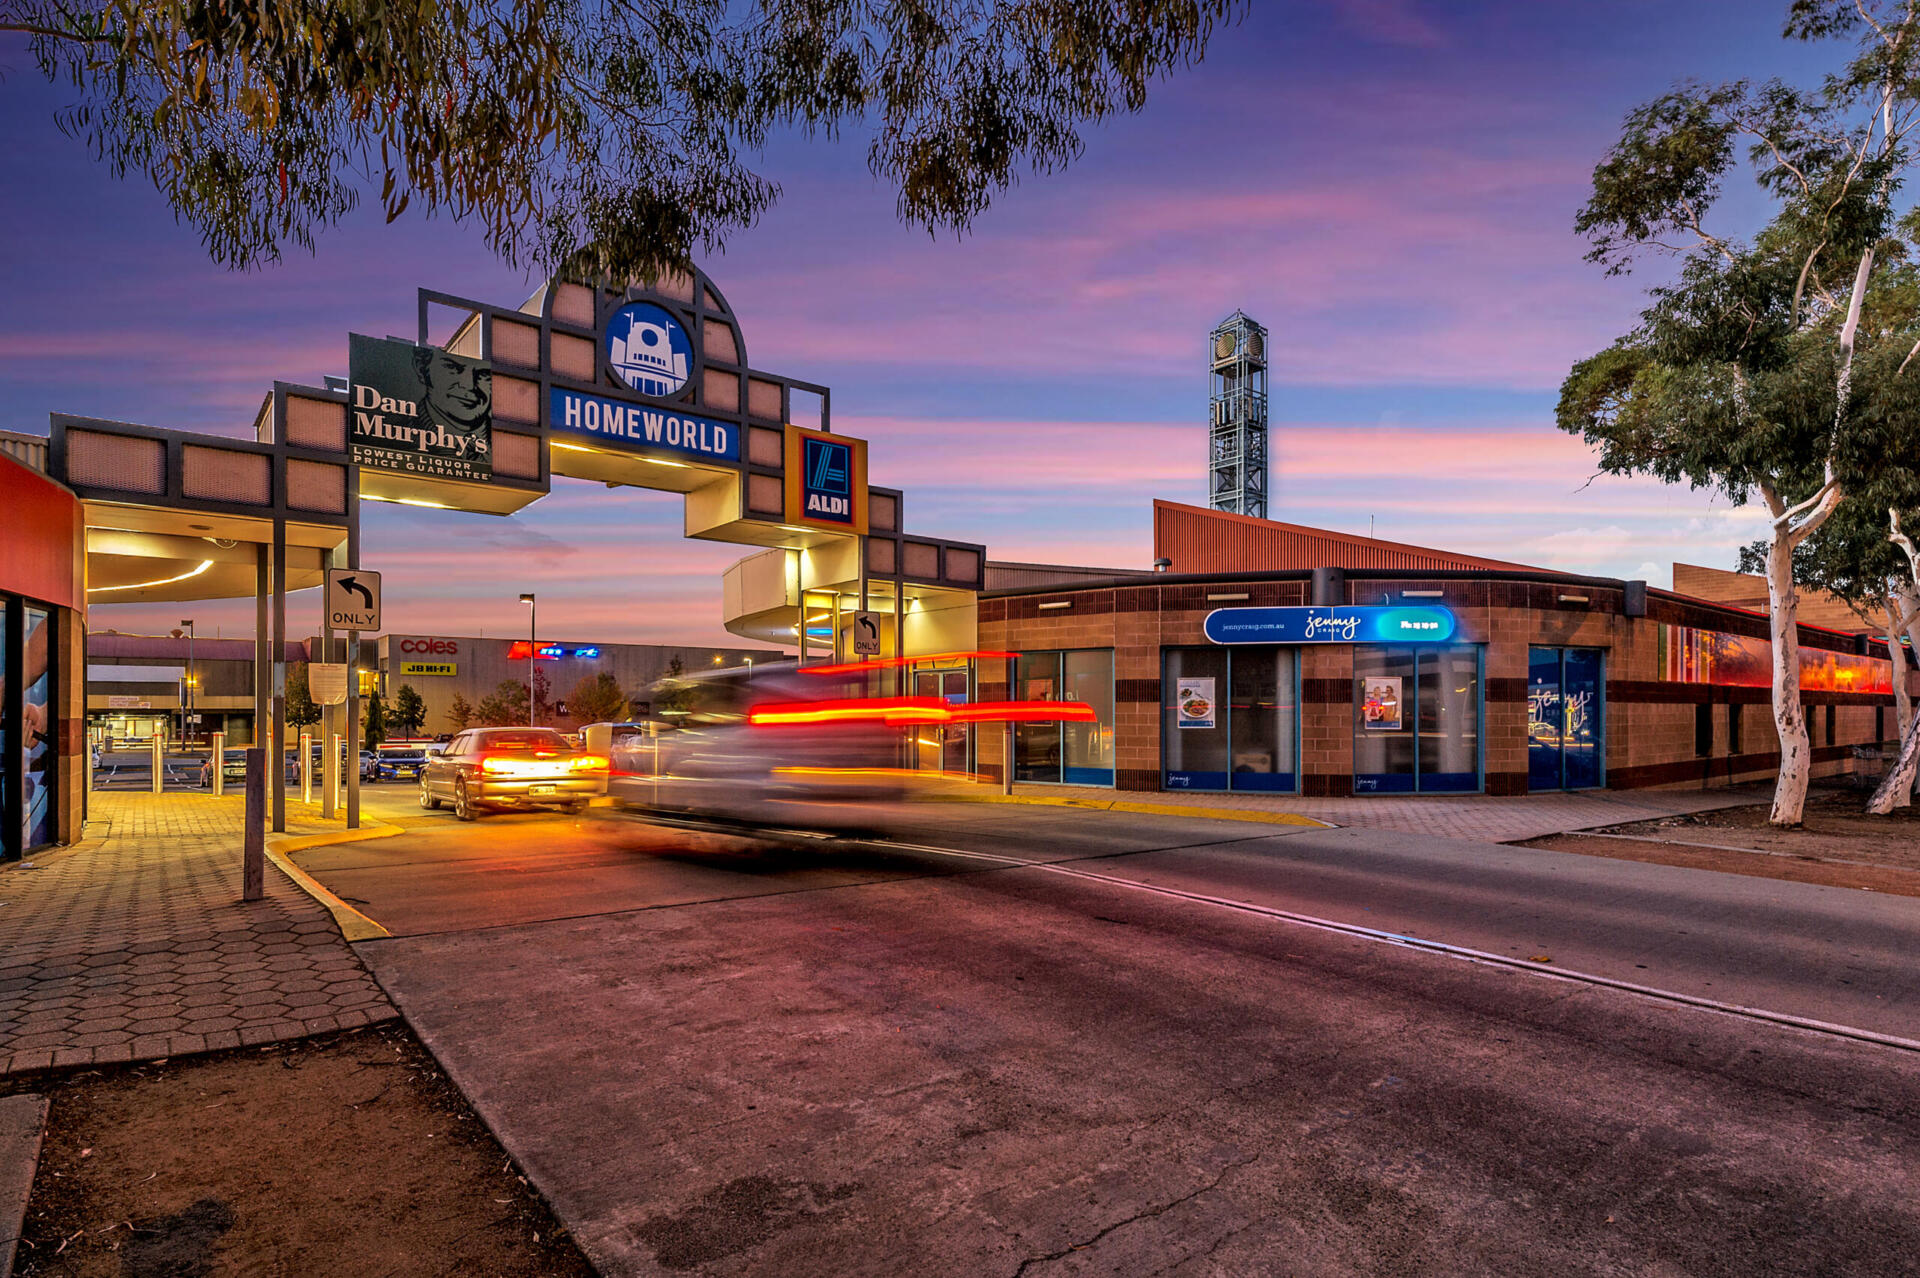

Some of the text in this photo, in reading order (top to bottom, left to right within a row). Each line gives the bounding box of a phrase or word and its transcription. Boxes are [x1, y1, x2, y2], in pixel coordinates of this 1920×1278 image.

[353, 384, 419, 418] Dan
[353, 411, 488, 457] Murphy's
[564, 395, 728, 455] HOMEWORLD
[353, 446, 472, 471] LOWEST LIQUOR
[353, 455, 490, 481] PRICE GUARANTEE
[807, 493, 849, 516] ALDI
[332, 612, 376, 625] ONLY
[1222, 623, 1286, 633] jennycraig.com.au
[1304, 609, 1362, 641] jenny
[400, 636, 458, 655] coles
[506, 640, 600, 660] Kmrt
[856, 641, 878, 650] ONLY
[407, 665, 451, 673] JB HI-FI
